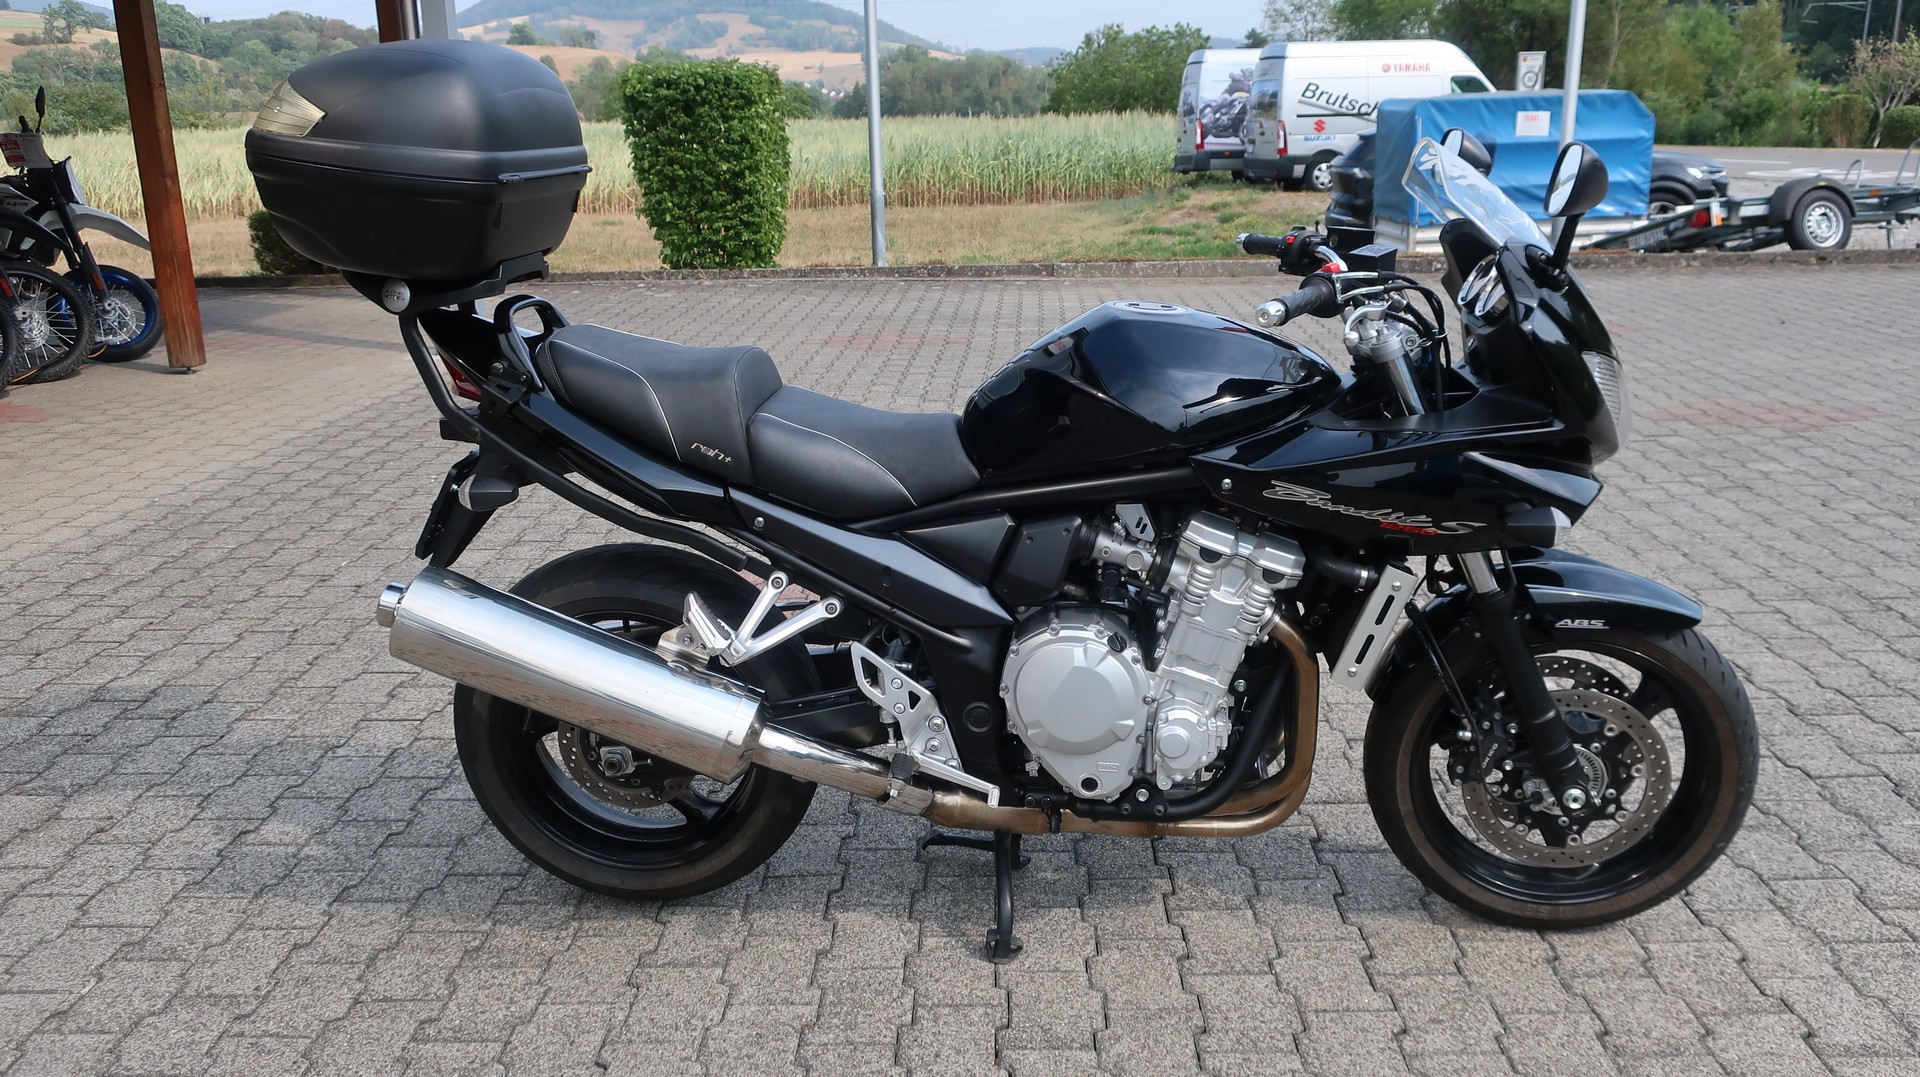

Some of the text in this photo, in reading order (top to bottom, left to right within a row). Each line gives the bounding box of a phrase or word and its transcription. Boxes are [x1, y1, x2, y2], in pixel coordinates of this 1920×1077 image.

[1393, 62, 1431, 73] YAMAHA
[1263, 480, 1433, 527] Bandit
[1555, 618, 1608, 629] ABS
